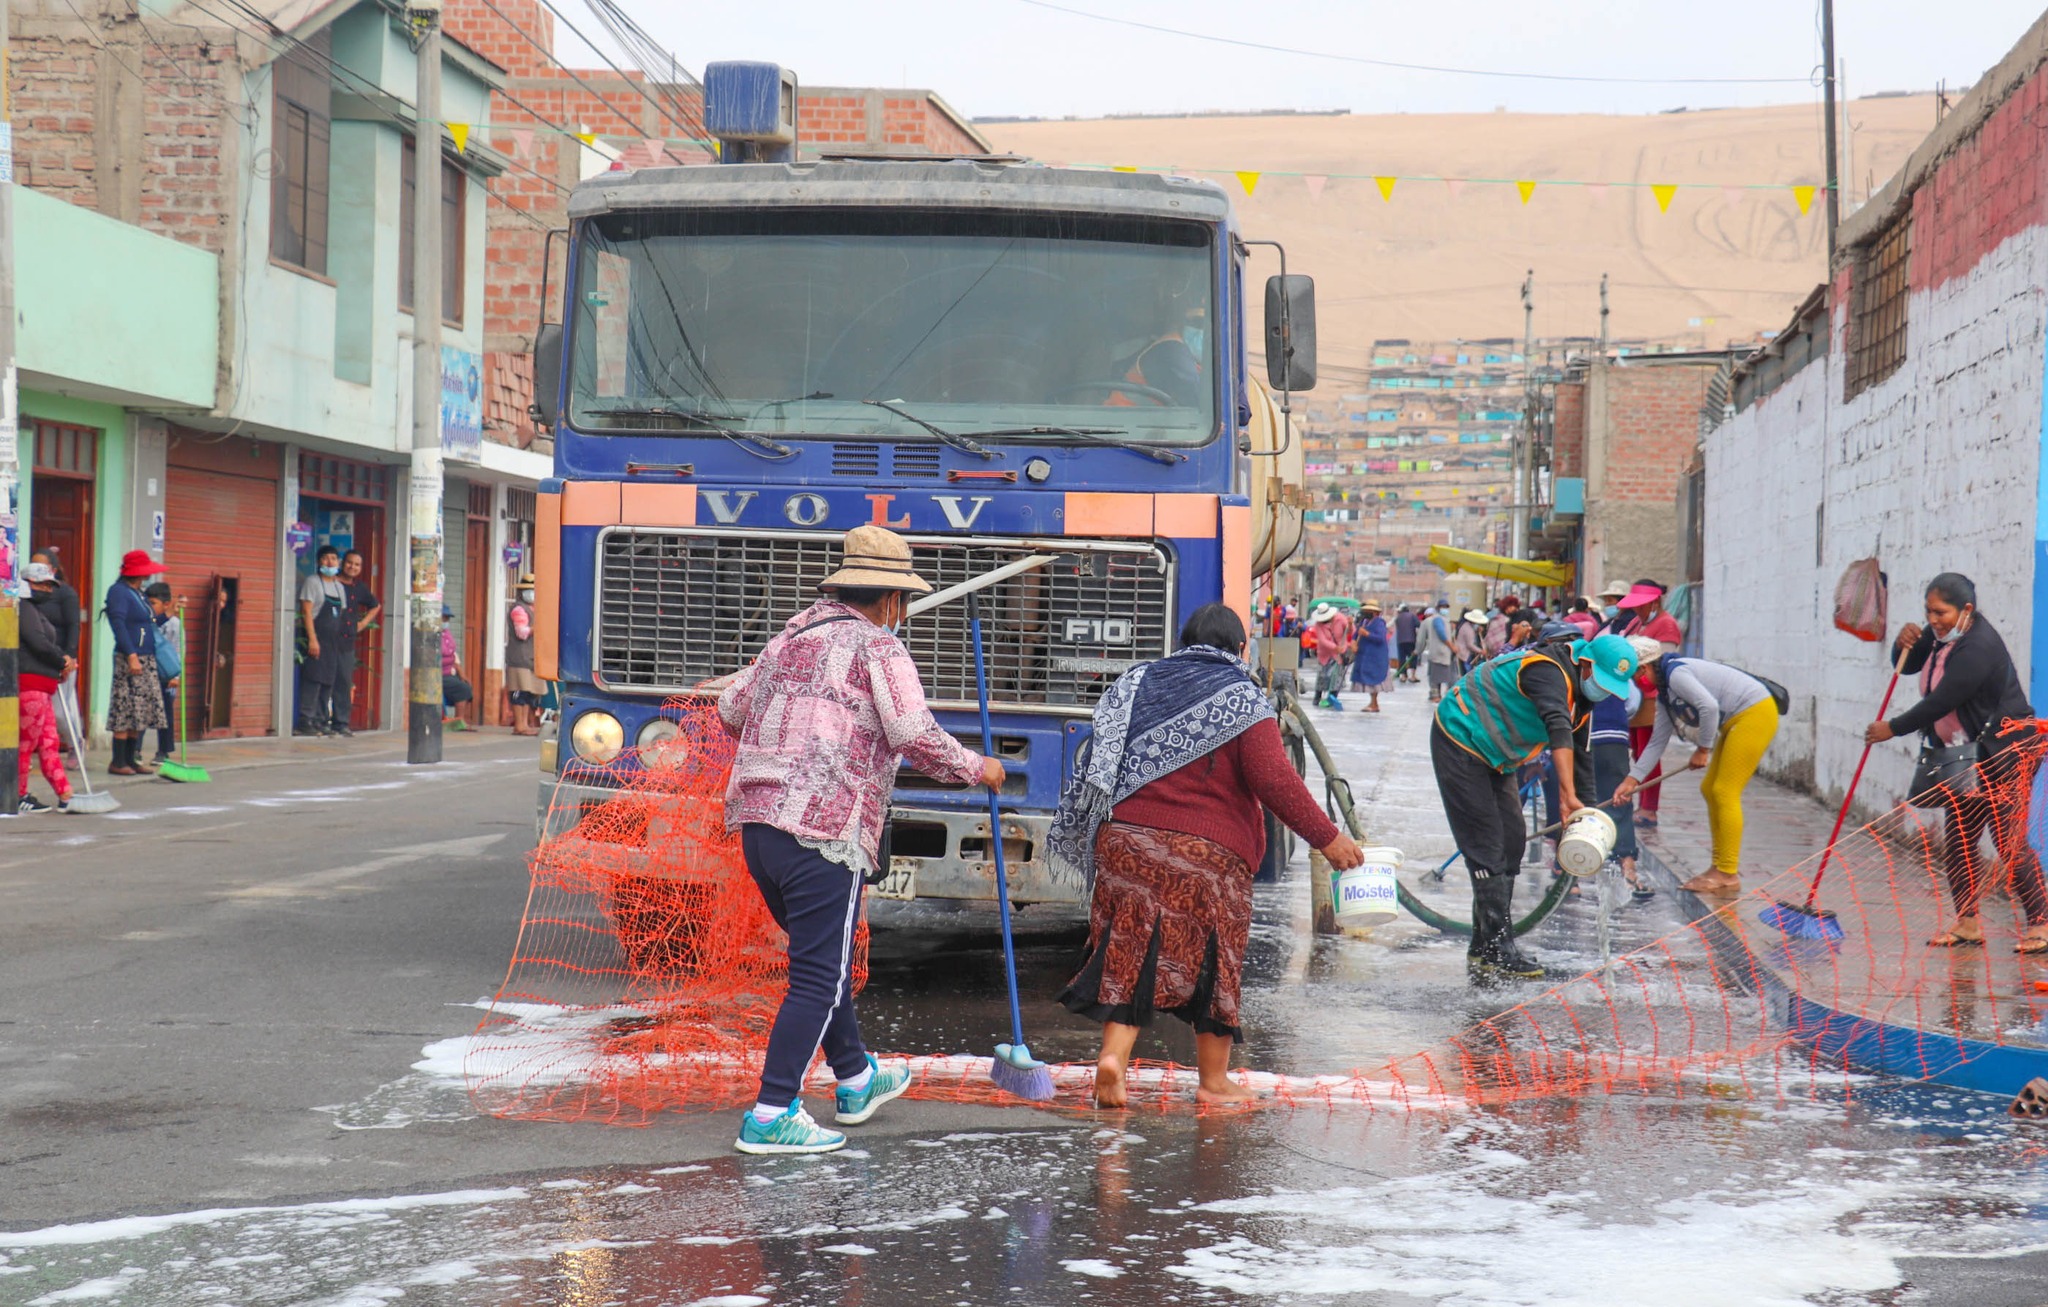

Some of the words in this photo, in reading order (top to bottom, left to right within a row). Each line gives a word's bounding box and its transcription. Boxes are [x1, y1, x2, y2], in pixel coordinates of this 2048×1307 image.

[699, 490, 993, 529] VOLV
[1066, 618, 1128, 642] F10
[1362, 866, 1392, 875] TEKNO
[1344, 884, 1395, 901] Moistek
